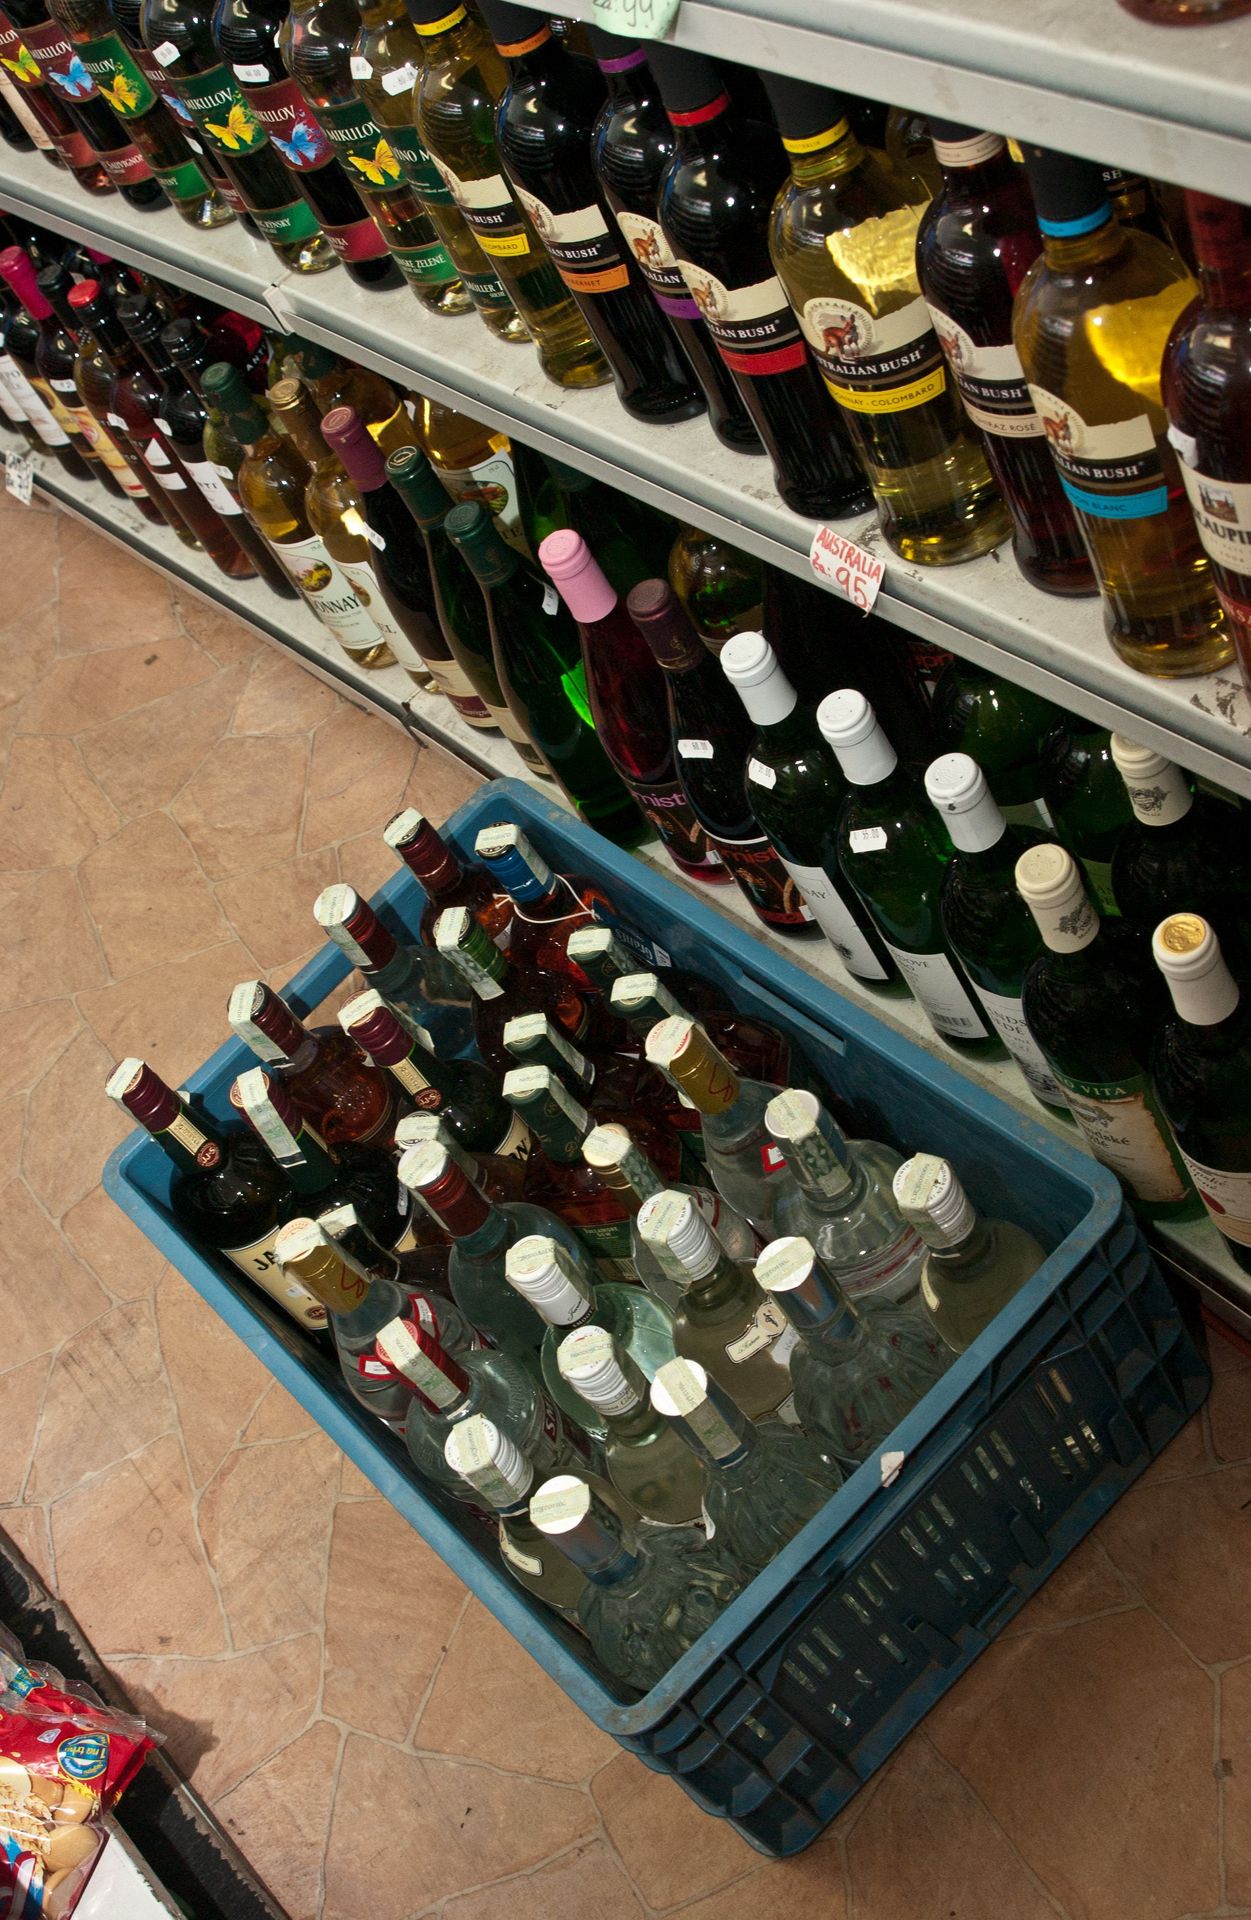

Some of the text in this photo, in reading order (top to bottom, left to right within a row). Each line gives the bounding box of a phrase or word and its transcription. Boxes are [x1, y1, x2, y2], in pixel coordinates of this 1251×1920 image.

[184, 88, 232, 111] MIKULOV
[475, 213, 504, 225] BUSH
[566, 246, 600, 260] BUSH
[738, 323, 777, 340] BUSH
[880, 349, 923, 375] BUSH
[870, 383, 936, 408] COLOMBARD
[981, 385, 1023, 399] BUSH
[1094, 464, 1140, 479] BUSH
[816, 527, 882, 584] AUSTRALIA
[1081, 1085, 1128, 1097] VITA
